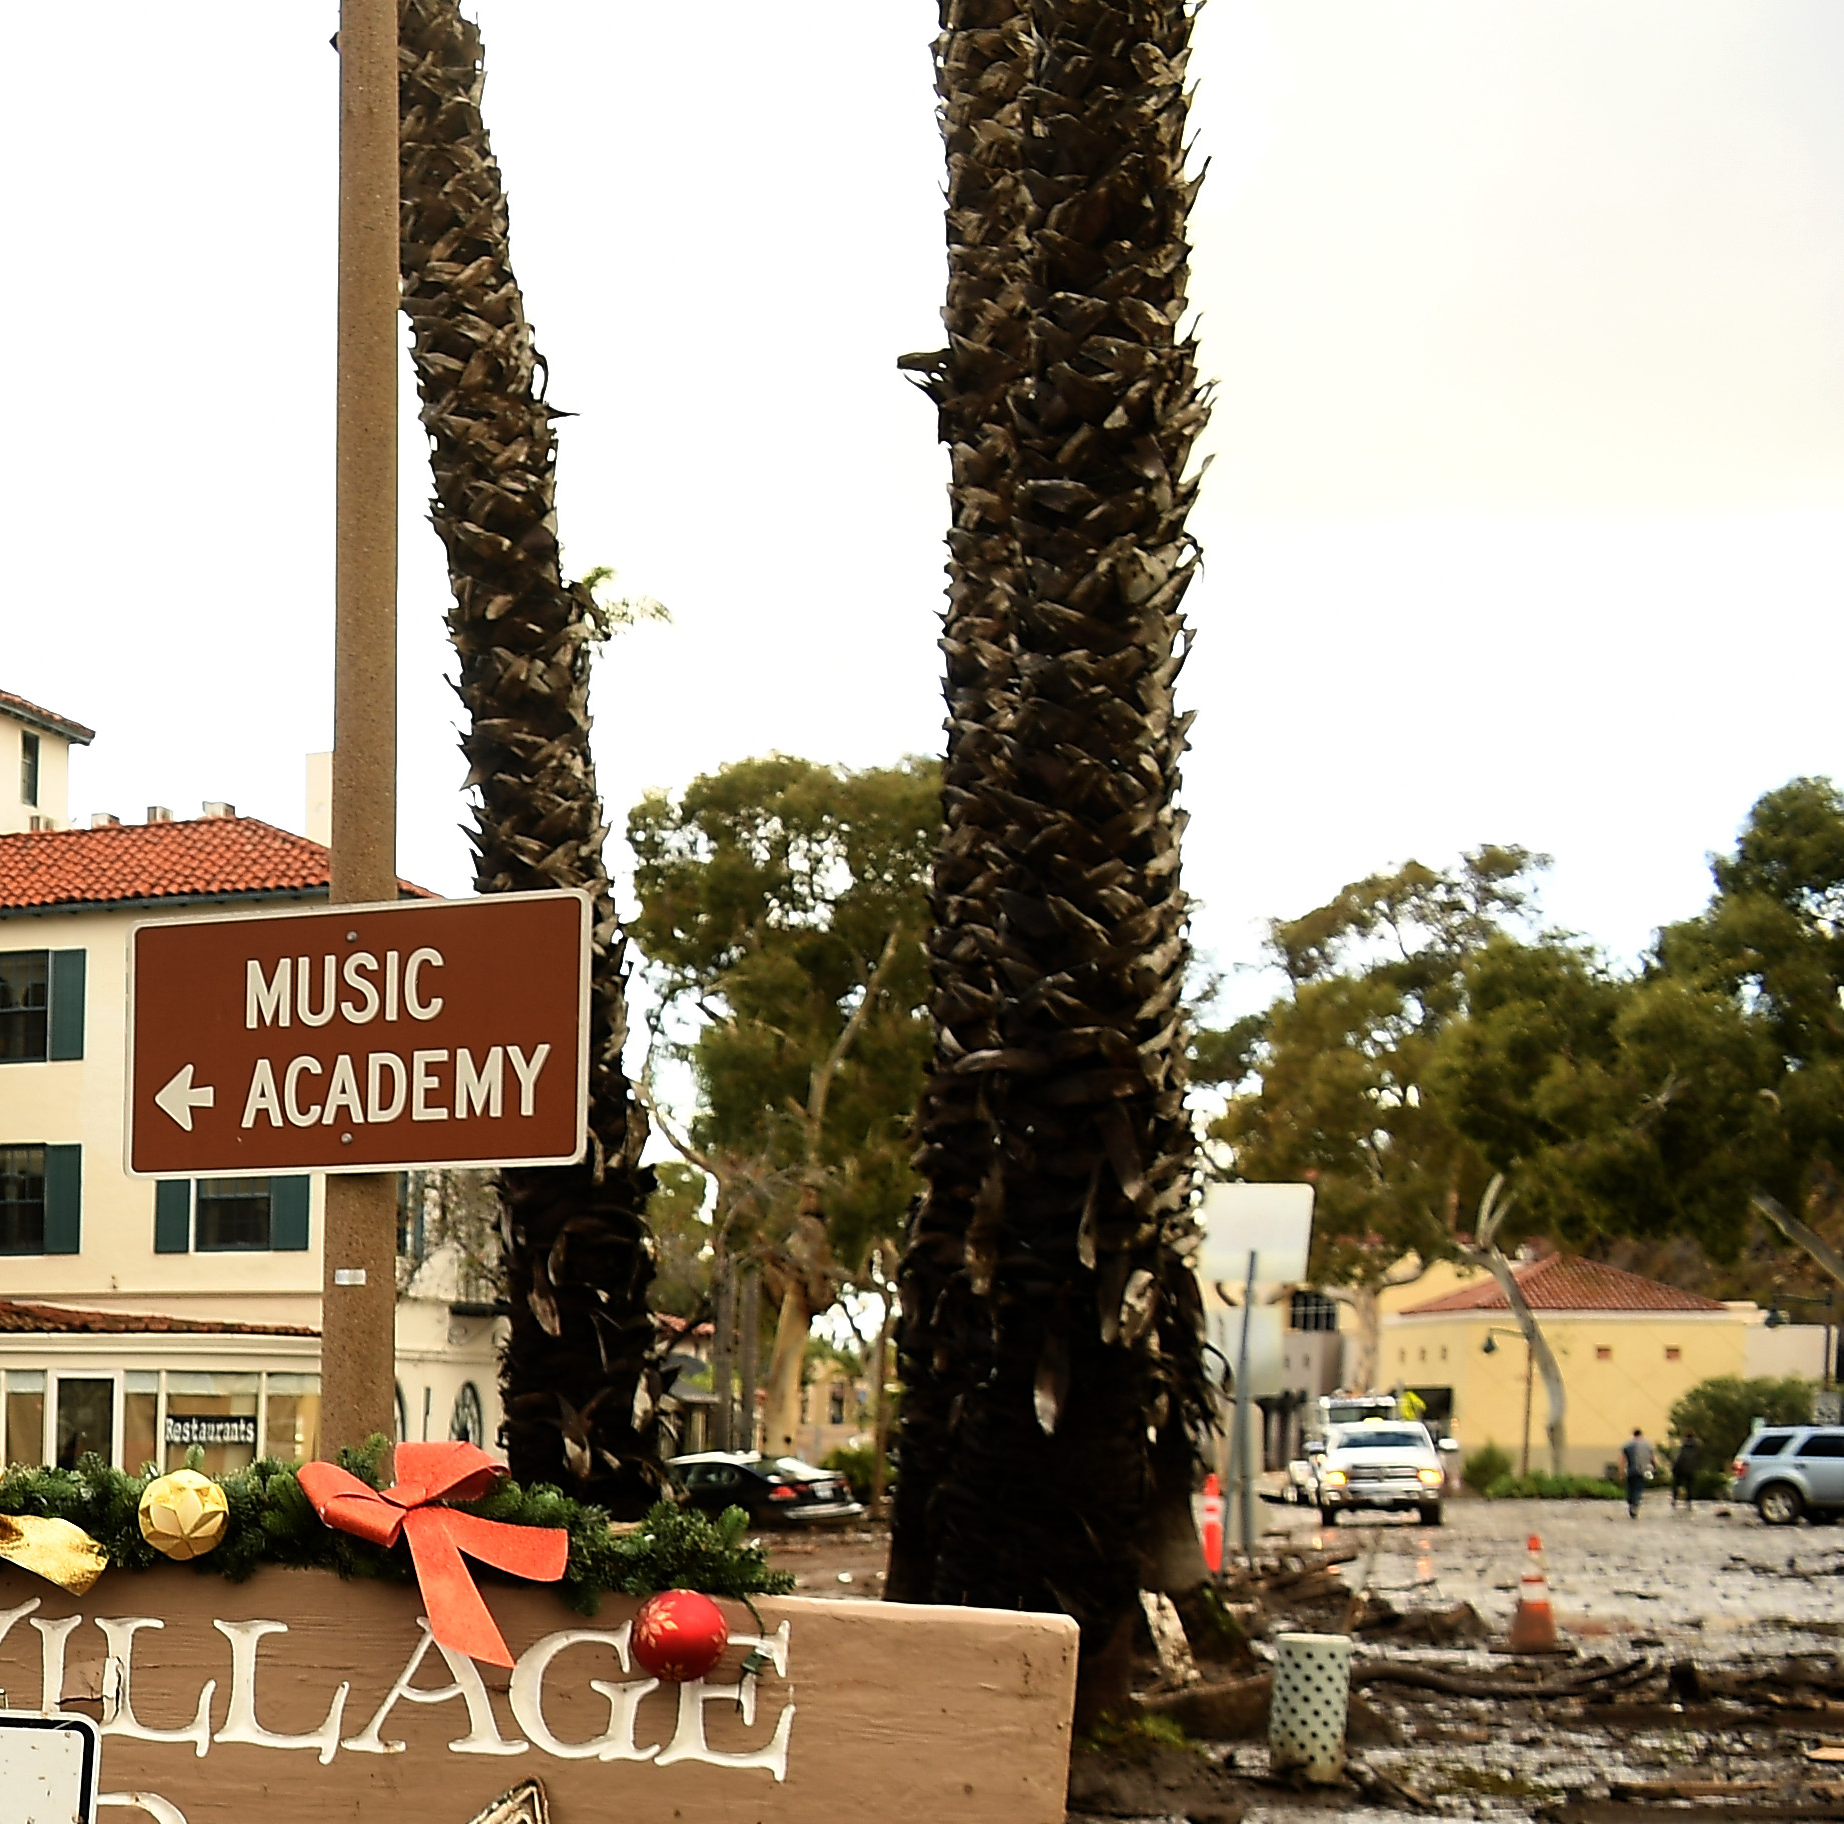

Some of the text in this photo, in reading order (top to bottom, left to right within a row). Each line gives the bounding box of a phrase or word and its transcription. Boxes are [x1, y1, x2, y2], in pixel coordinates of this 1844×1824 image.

[245, 947, 445, 1030] MUSIC
[240, 1043, 552, 1129] ACADEMY
[165, 1417, 255, 1443] Restaurants
